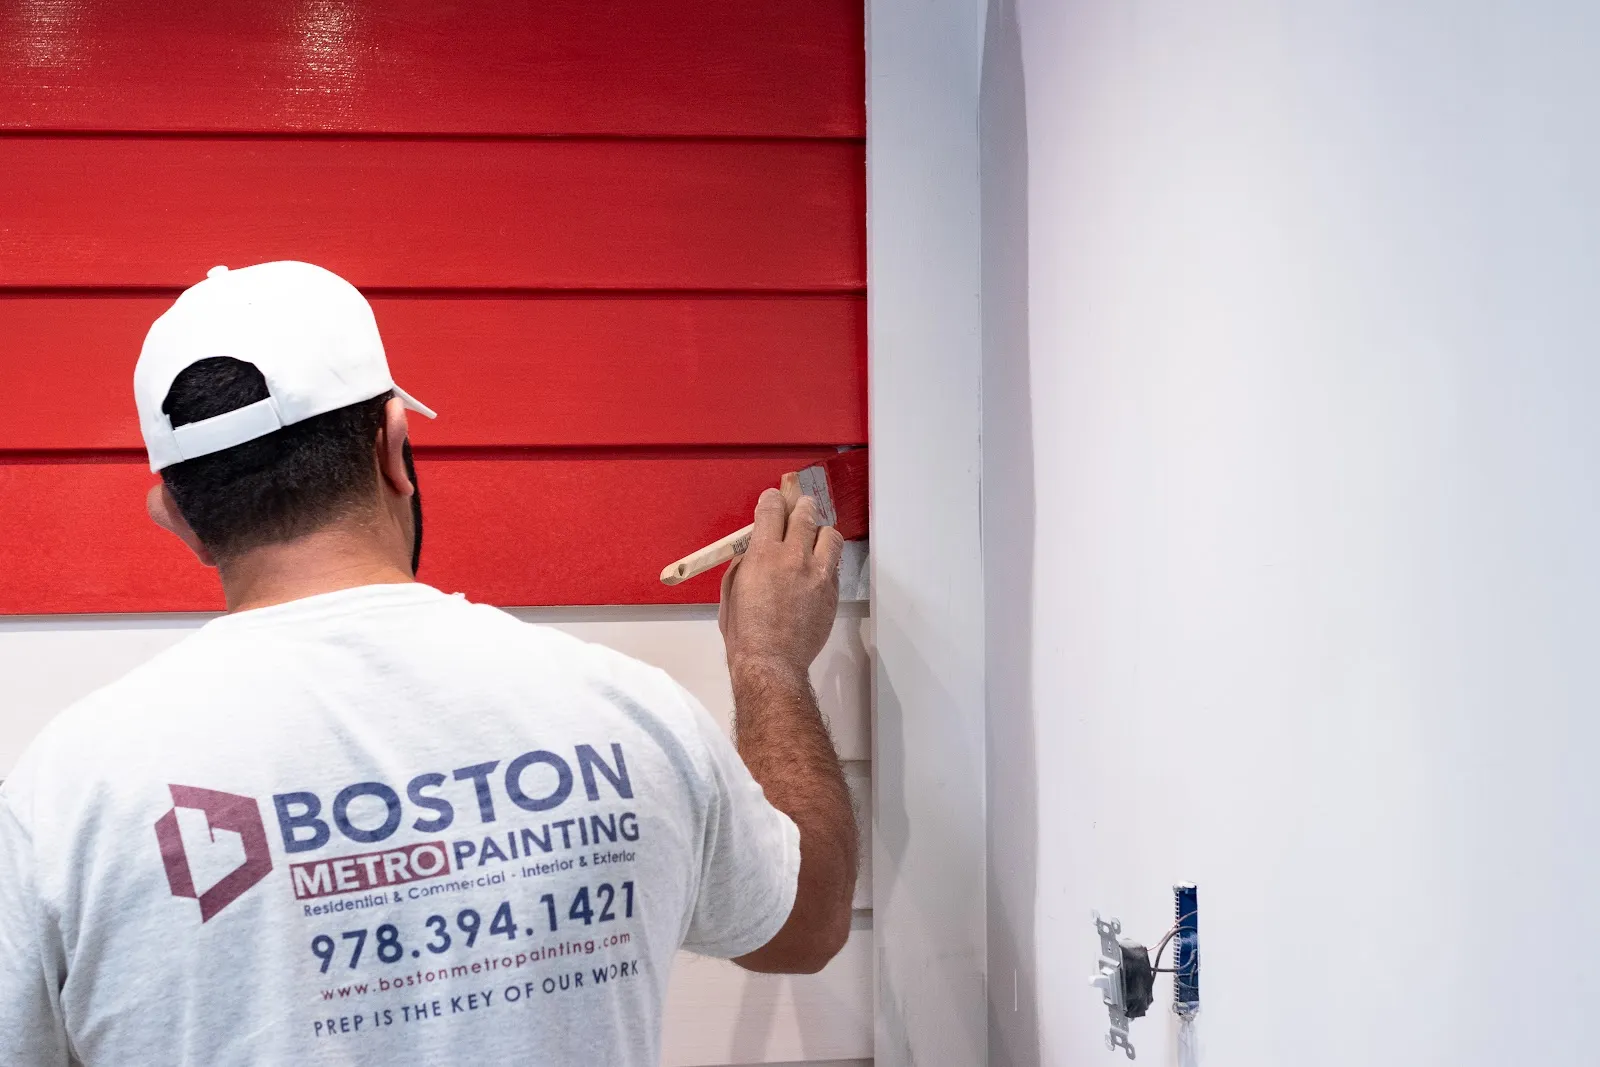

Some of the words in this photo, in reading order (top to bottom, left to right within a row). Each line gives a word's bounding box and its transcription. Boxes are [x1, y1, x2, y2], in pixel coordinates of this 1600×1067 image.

[272, 743, 634, 853] BOSTON
[293, 845, 445, 898] METRO
[452, 812, 639, 870] PAINTING
[303, 893, 388, 917] Residential
[393, 892, 403, 903] &
[409, 871, 505, 899] Commercial
[522, 858, 574, 878] Interior
[579, 856, 588, 866] &
[593, 850, 636, 865] Exterior
[311, 881, 635, 975] 978.394.1421
[321, 932, 631, 1001] www.bostonmetropainting.com
[314, 1015, 363, 1037] PREP
[375, 1009, 393, 1027] IS
[402, 1001, 441, 1023] THE
[452, 991, 492, 1014] KEY
[504, 983, 534, 1002] OF
[542, 972, 584, 993] OUR
[592, 960, 639, 983] WORK
